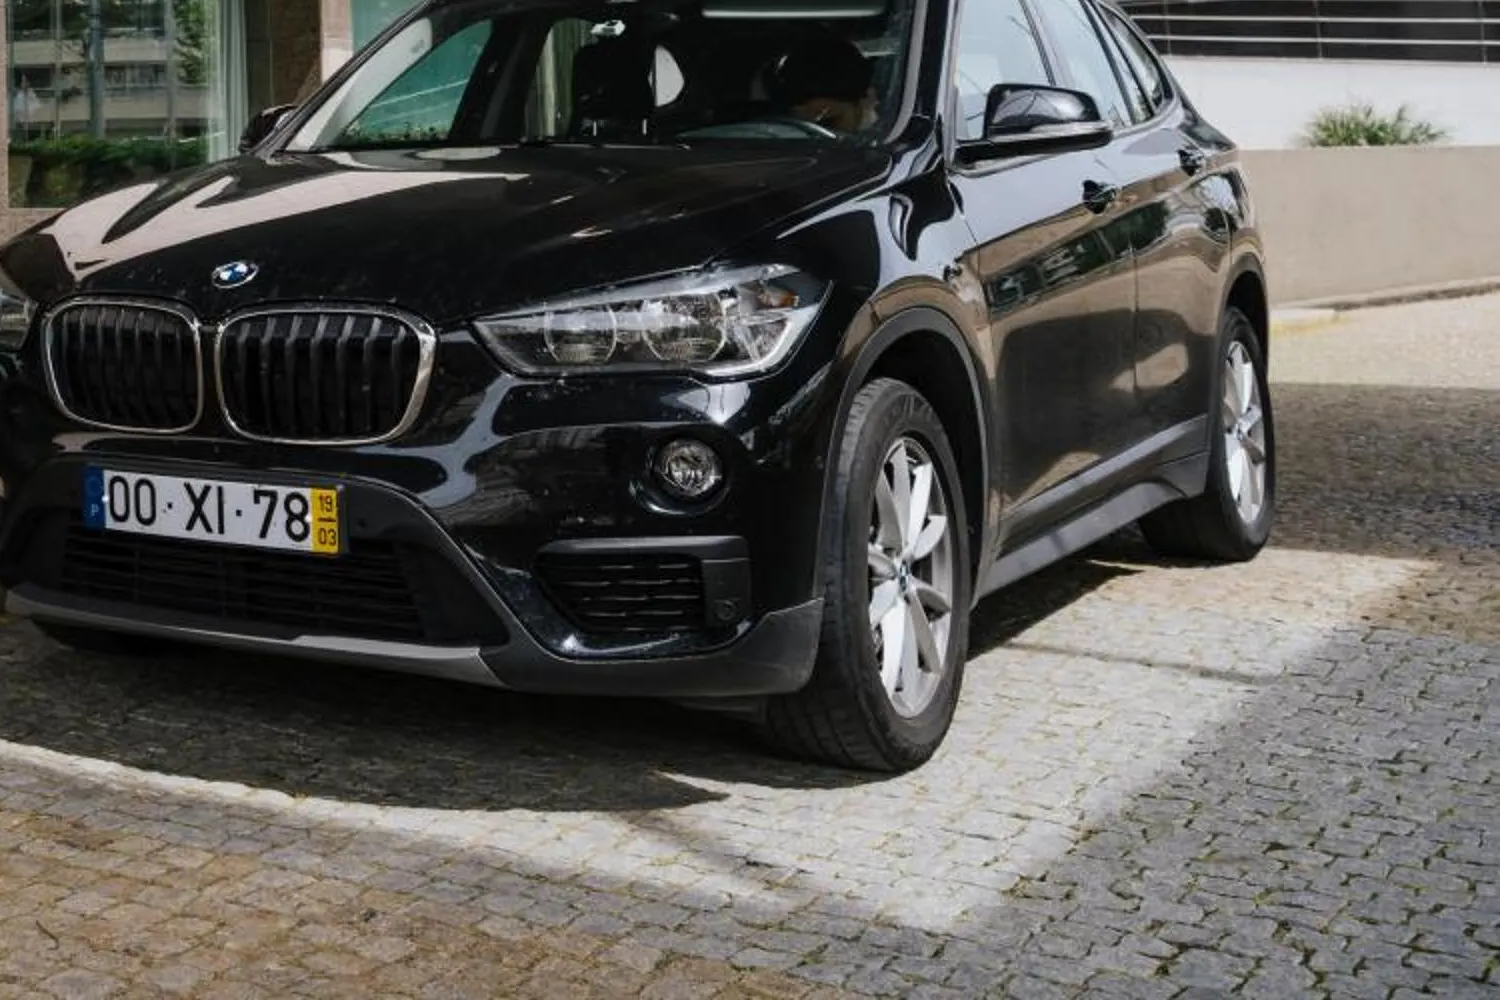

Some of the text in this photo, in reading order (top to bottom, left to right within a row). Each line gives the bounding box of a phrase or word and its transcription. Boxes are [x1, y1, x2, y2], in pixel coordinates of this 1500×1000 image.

[90, 503, 100, 517] P
[318, 494, 333, 513] 19
[317, 528, 337, 545] 03
